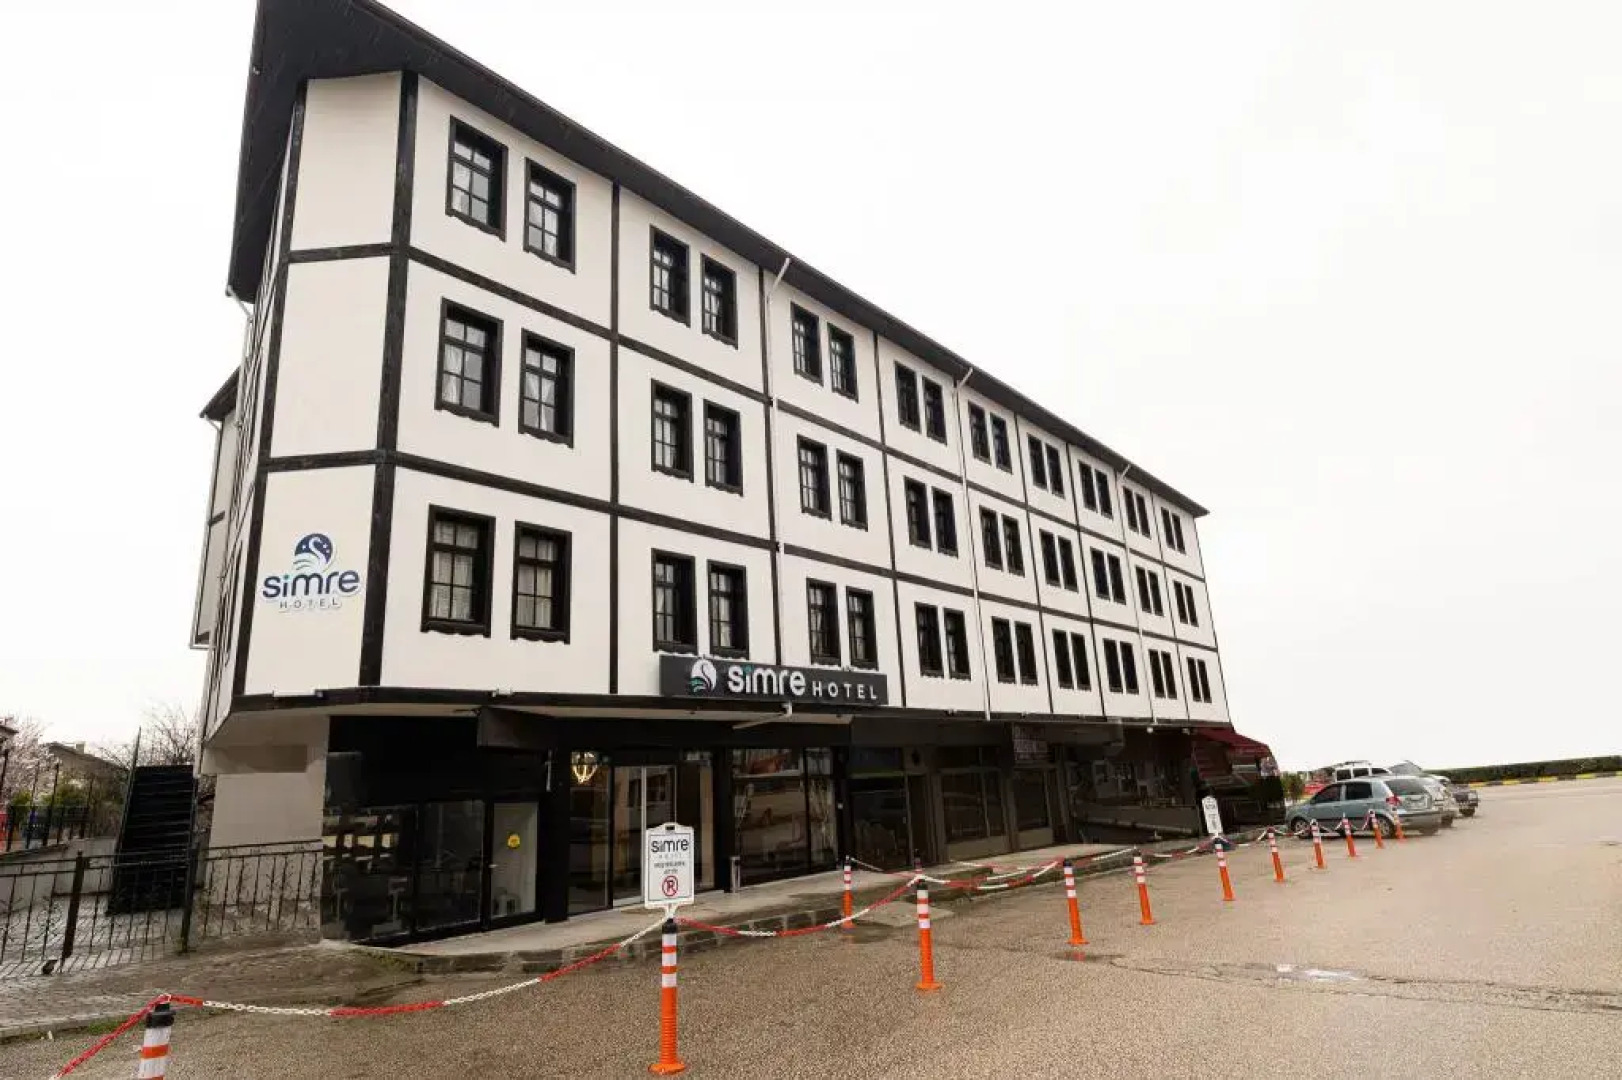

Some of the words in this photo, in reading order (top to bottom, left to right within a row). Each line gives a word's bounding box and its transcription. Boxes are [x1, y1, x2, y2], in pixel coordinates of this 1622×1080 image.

[263, 570, 360, 598] simre
[280, 598, 338, 609] HOTEL
[728, 665, 806, 696] simre
[812, 680, 877, 700] HOTEL
[651, 838, 689, 853] simre
